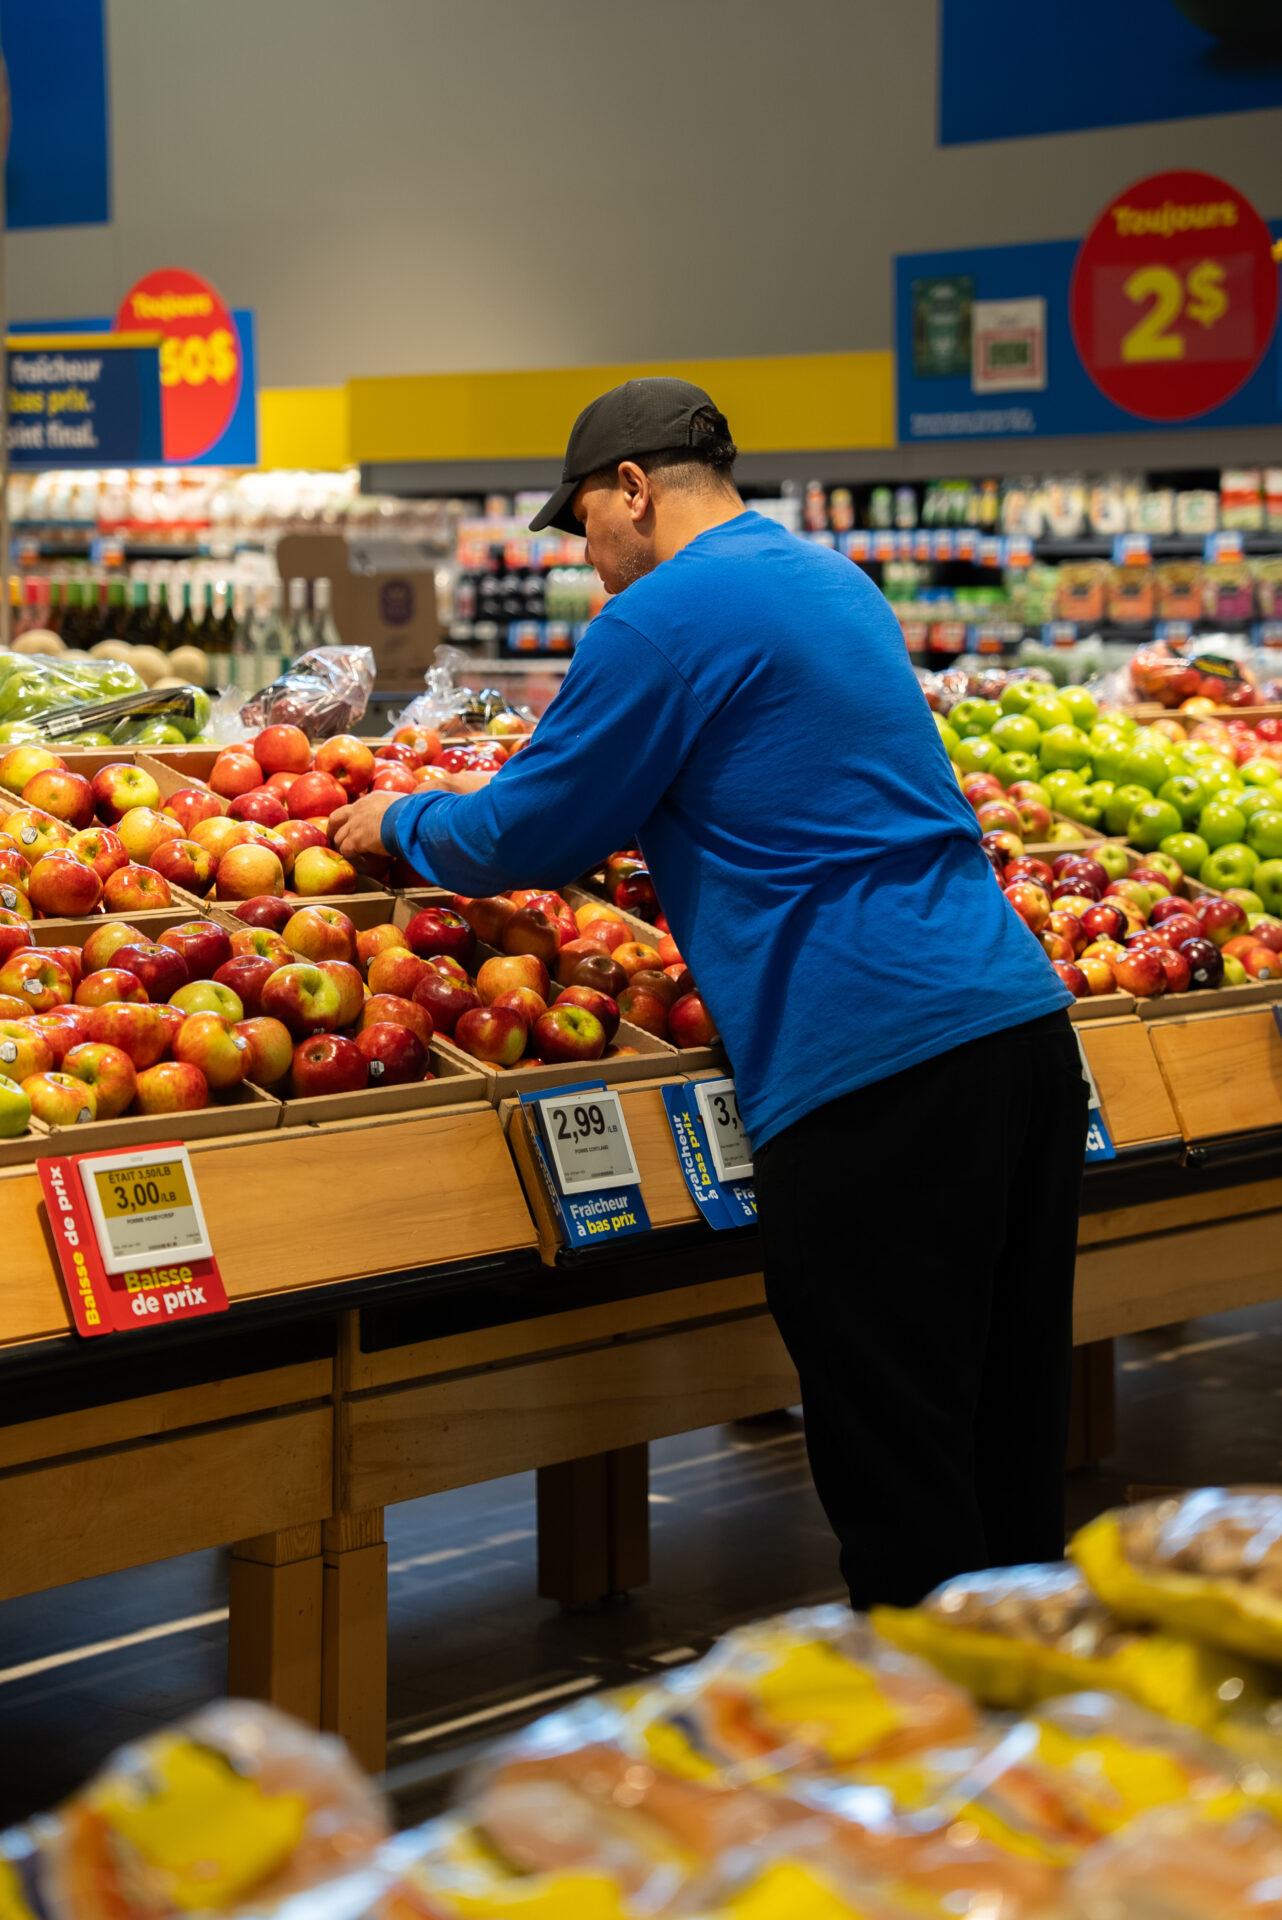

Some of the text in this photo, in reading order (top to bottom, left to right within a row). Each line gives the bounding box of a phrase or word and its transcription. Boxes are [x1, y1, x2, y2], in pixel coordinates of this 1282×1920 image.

[1112, 201, 1238, 237] Toujours
[132, 292, 213, 321] Toujours
[1121, 258, 1229, 364] 2$
[553, 1104, 606, 1145] 2,99
[713, 1094, 744, 1129] 3,
[672, 1114, 709, 1202] Fraîcheur
[682, 1111, 720, 1200] à bas prix
[108, 1170, 136, 1184] ÉTAIT
[114, 1181, 160, 1212] 3,00
[570, 1195, 629, 1220] Fraîcheur
[577, 1211, 637, 1237] à bas prix
[50, 1166, 100, 1326] Baisse de prix
[124, 1266, 193, 1294] Baisse
[131, 1285, 207, 1316] de prix
